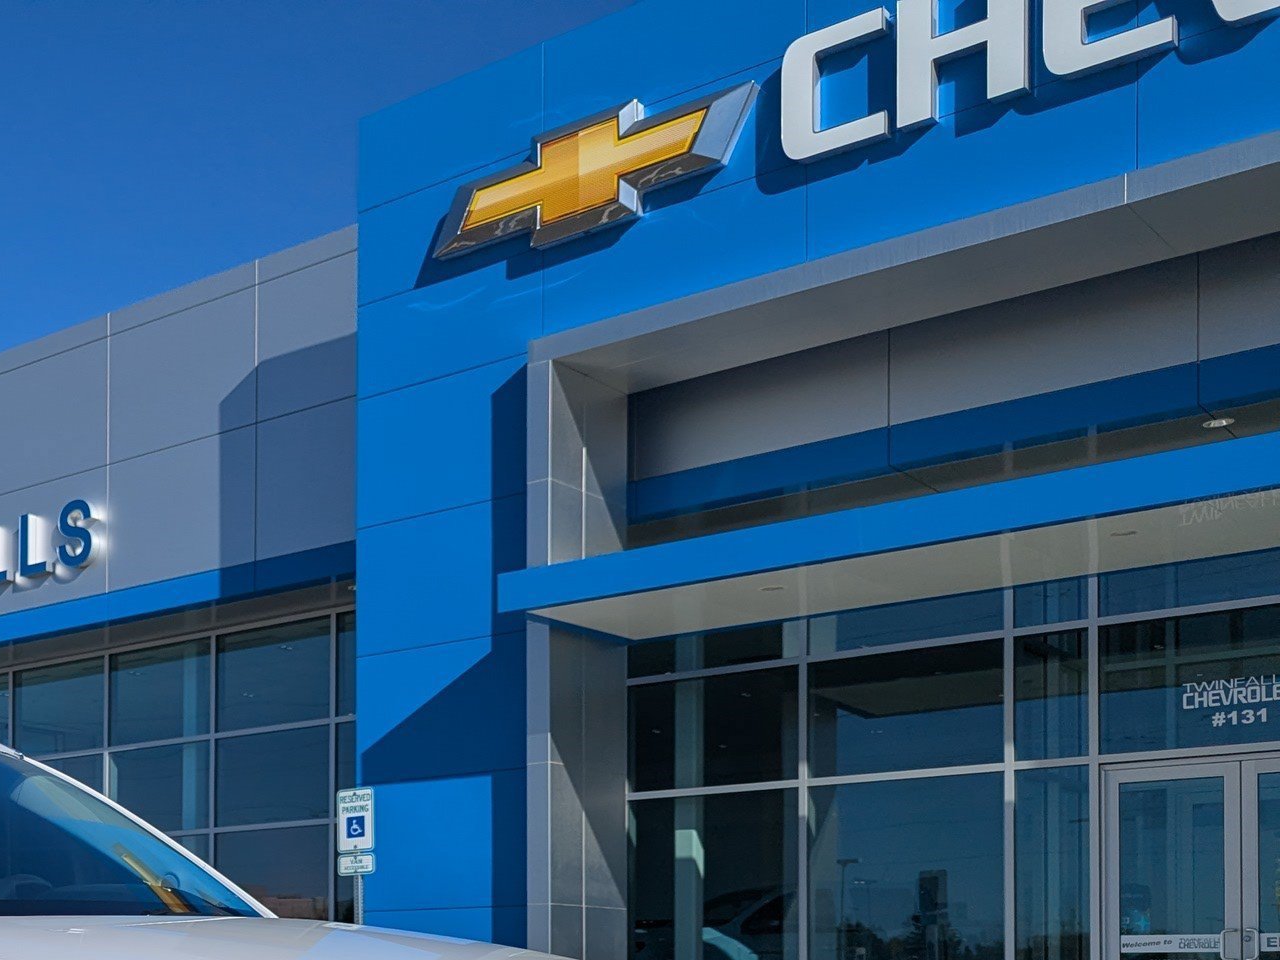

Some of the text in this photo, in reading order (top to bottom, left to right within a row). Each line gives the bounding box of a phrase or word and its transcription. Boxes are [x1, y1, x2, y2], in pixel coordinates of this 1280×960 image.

[781, 0, 1280, 161] CHE
[1212, 708, 1268, 727] #131
[340, 793, 370, 804] RESERVED
[342, 804, 369, 814] PARKING
[1122, 941, 1161, 949] Welcome
[1179, 941, 1220, 949] CHEVROLE
[1267, 937, 1280, 947] E
